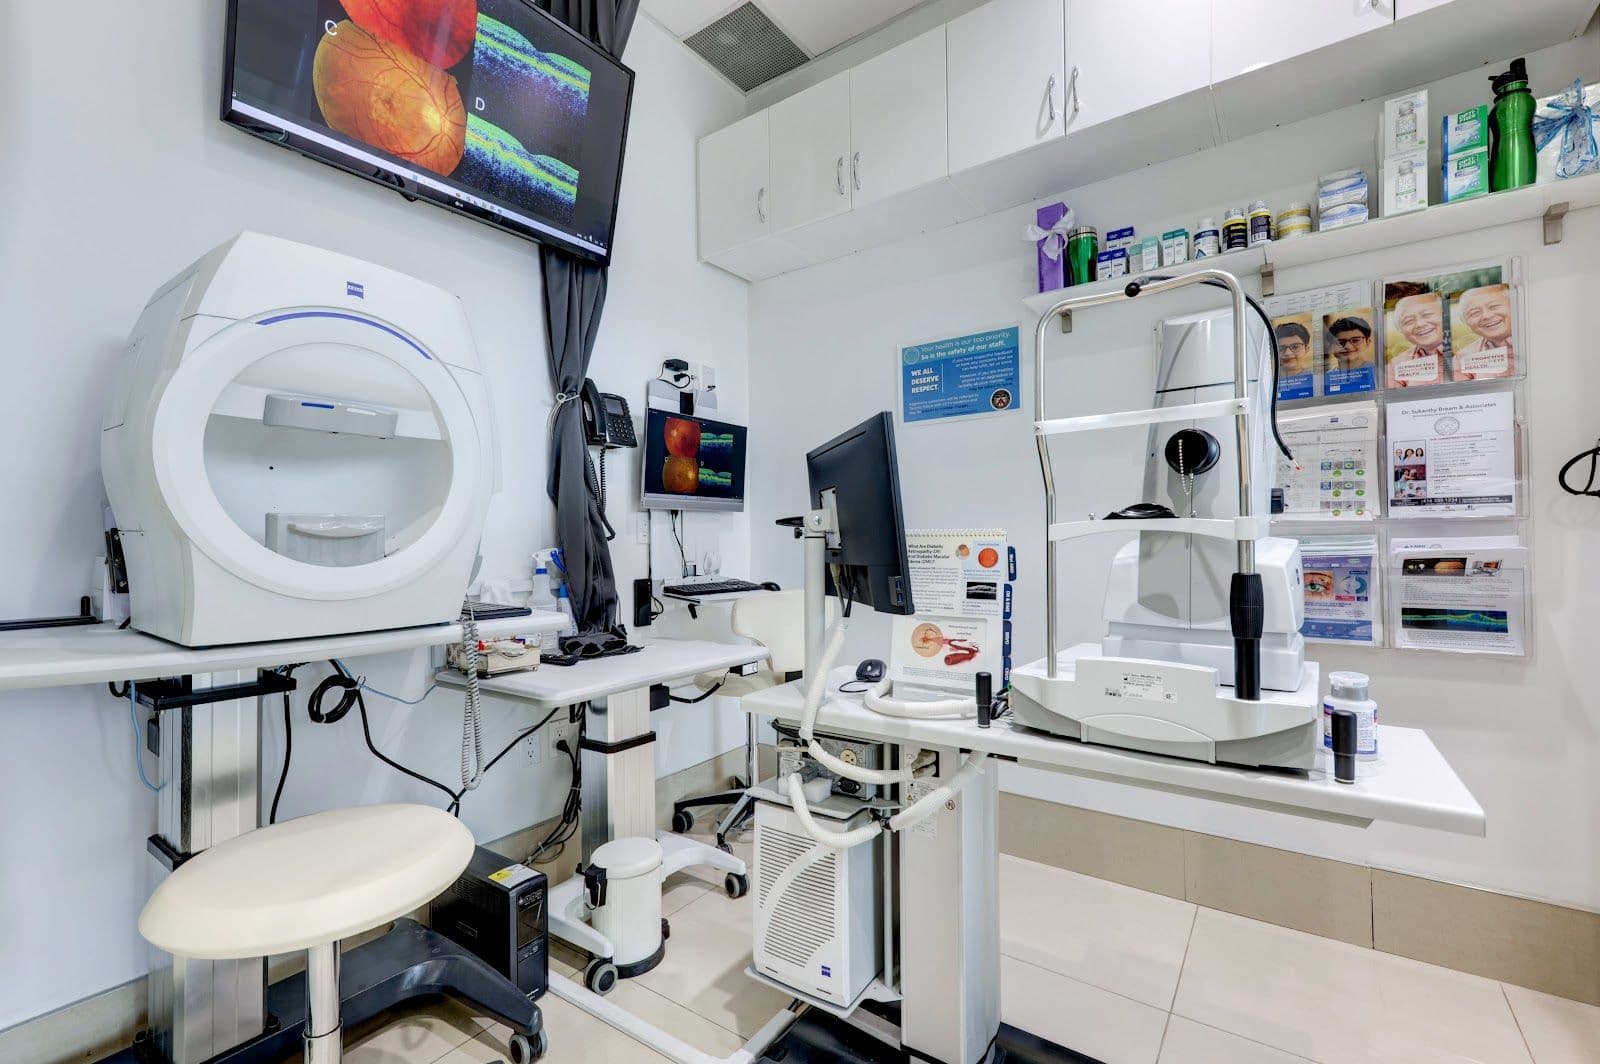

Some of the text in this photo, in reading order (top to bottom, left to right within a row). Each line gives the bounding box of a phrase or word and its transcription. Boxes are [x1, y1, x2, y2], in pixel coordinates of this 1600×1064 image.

[324, 19, 338, 36] C
[475, 97, 486, 111] D
[974, 336, 985, 345] top
[936, 350, 947, 358] the
[948, 347, 966, 356] safety
[912, 375, 939, 385] DESERVE
